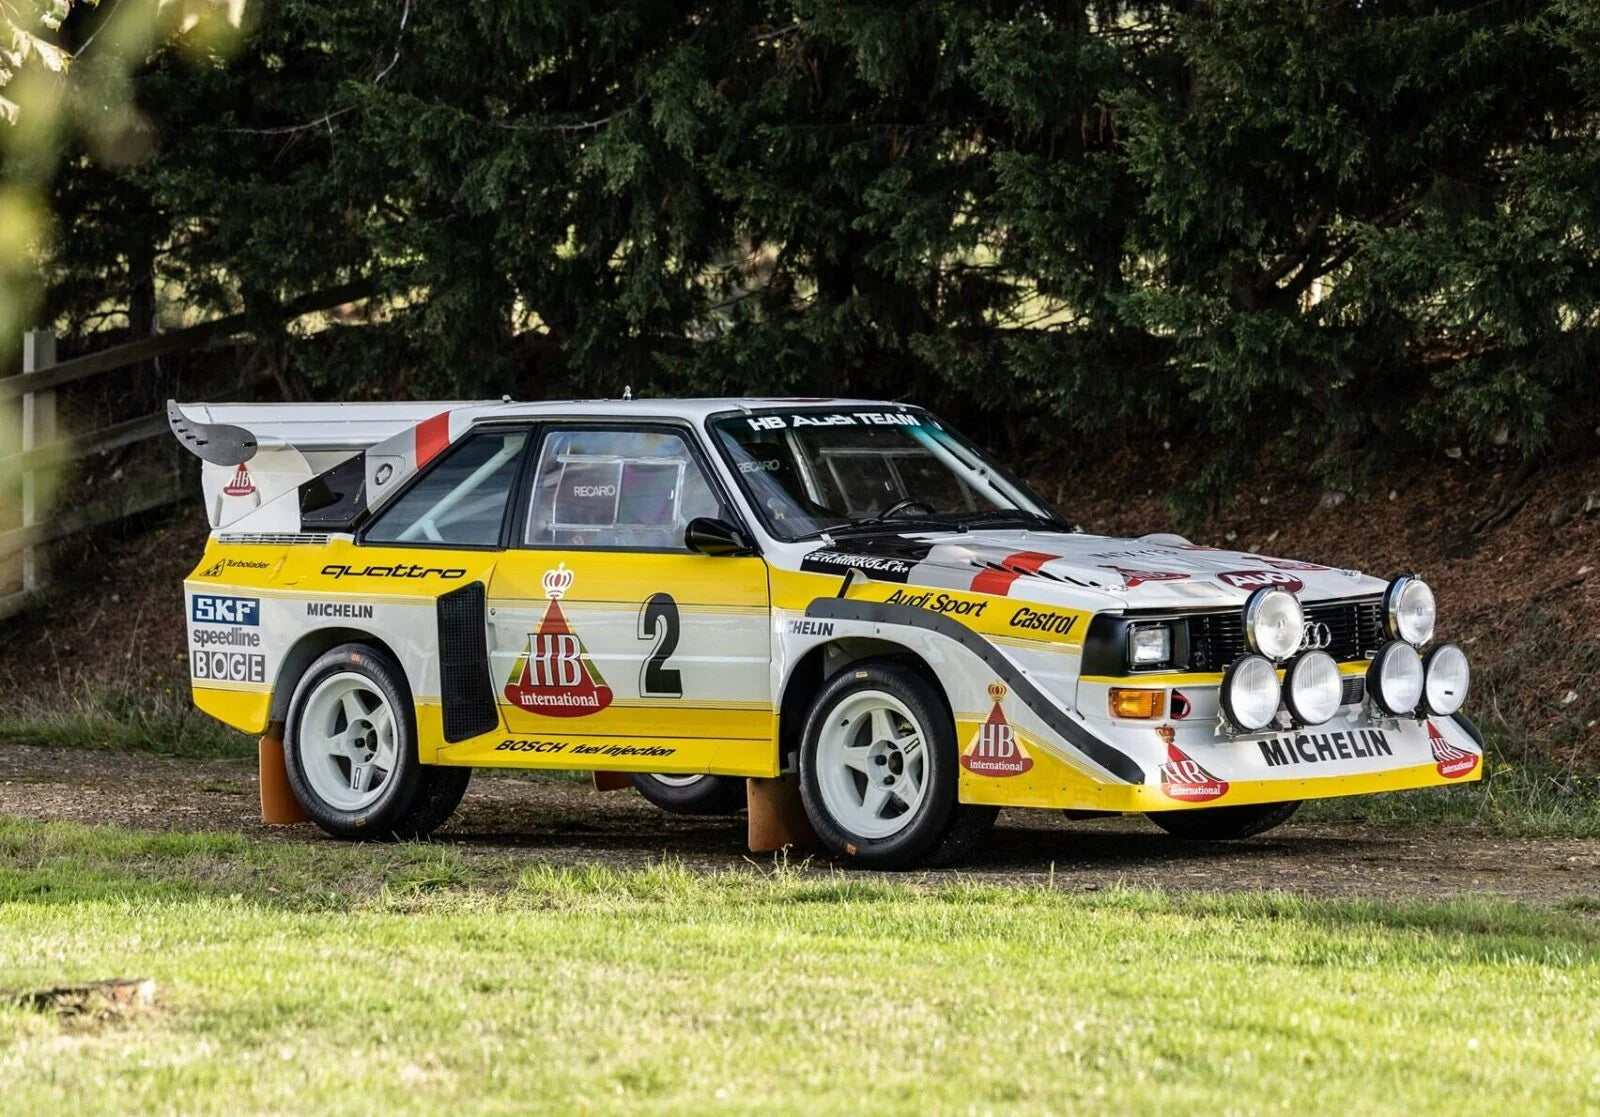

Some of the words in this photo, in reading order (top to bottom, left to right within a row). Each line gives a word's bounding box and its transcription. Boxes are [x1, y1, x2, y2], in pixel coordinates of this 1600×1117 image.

[747, 416, 787, 431] HB
[853, 413, 921, 426] TEAM
[737, 459, 780, 474] RECARO
[573, 485, 616, 497] RECARO
[226, 559, 270, 569] Turbolader
[320, 564, 467, 581] quattro
[195, 597, 257, 623] SKF
[307, 602, 373, 619] MICHELIN
[885, 589, 933, 608] Audi
[930, 594, 988, 617] Sport
[1009, 607, 1079, 635] Castrol
[193, 627, 260, 647] speedline
[637, 591, 683, 698] 2
[194, 651, 264, 682] BOGE
[528, 633, 582, 687] HB
[520, 691, 600, 707] international
[495, 740, 569, 753] BOSCH
[569, 744, 607, 754] fuel
[603, 745, 676, 757] injection
[978, 724, 1014, 758] HB
[1258, 729, 1393, 767] MICHELIN
[969, 760, 1023, 772] international
[1159, 759, 1208, 785] HB
[1169, 784, 1221, 797] international
